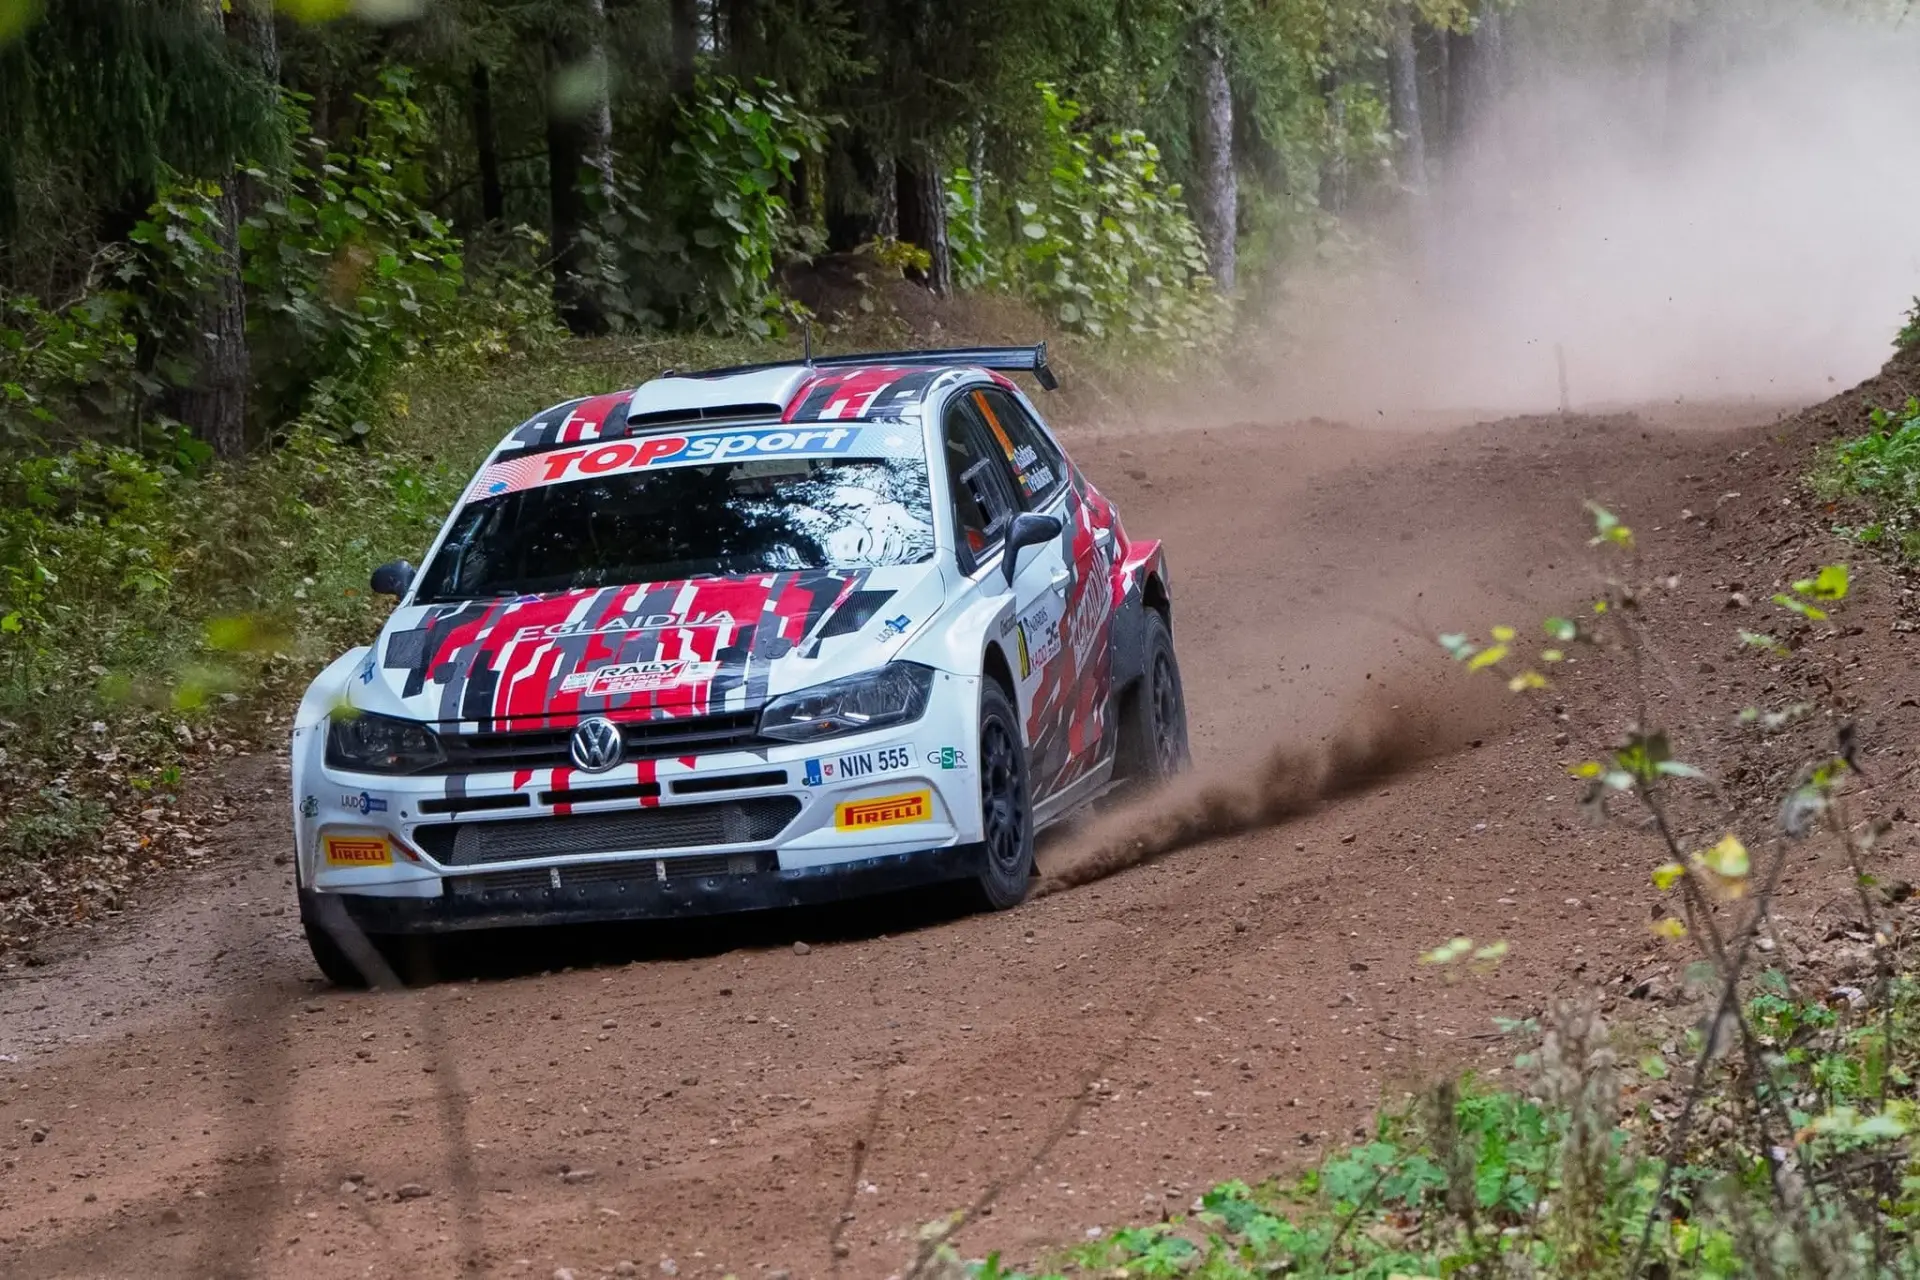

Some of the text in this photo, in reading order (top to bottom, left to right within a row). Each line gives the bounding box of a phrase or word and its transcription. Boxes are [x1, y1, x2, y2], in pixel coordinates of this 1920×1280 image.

[599, 662, 679, 677] RALLY
[839, 747, 909, 778] NIN 555
[926, 749, 967, 765] GSR
[844, 796, 922, 826] PIRELLI
[328, 840, 385, 861] PIRELLI
